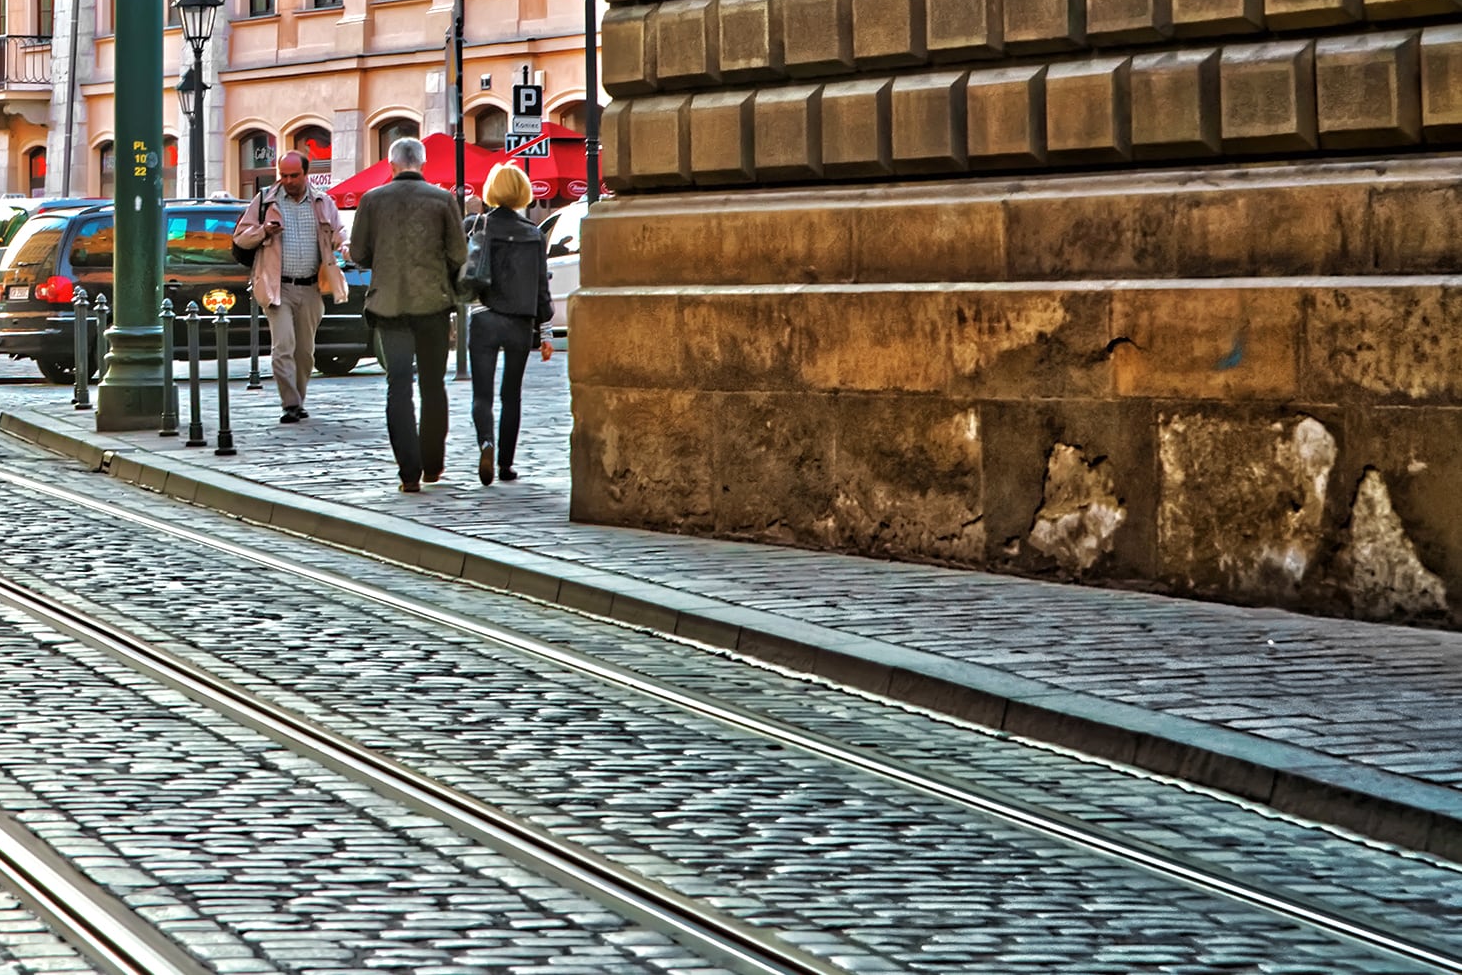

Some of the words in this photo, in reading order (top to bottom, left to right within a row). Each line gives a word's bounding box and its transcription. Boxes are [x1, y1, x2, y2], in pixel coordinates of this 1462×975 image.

[520, 88, 537, 114] P
[133, 141, 147, 150] PL
[507, 136, 547, 155] TAXI
[135, 154, 146, 163] 10
[134, 167, 147, 176] 22
